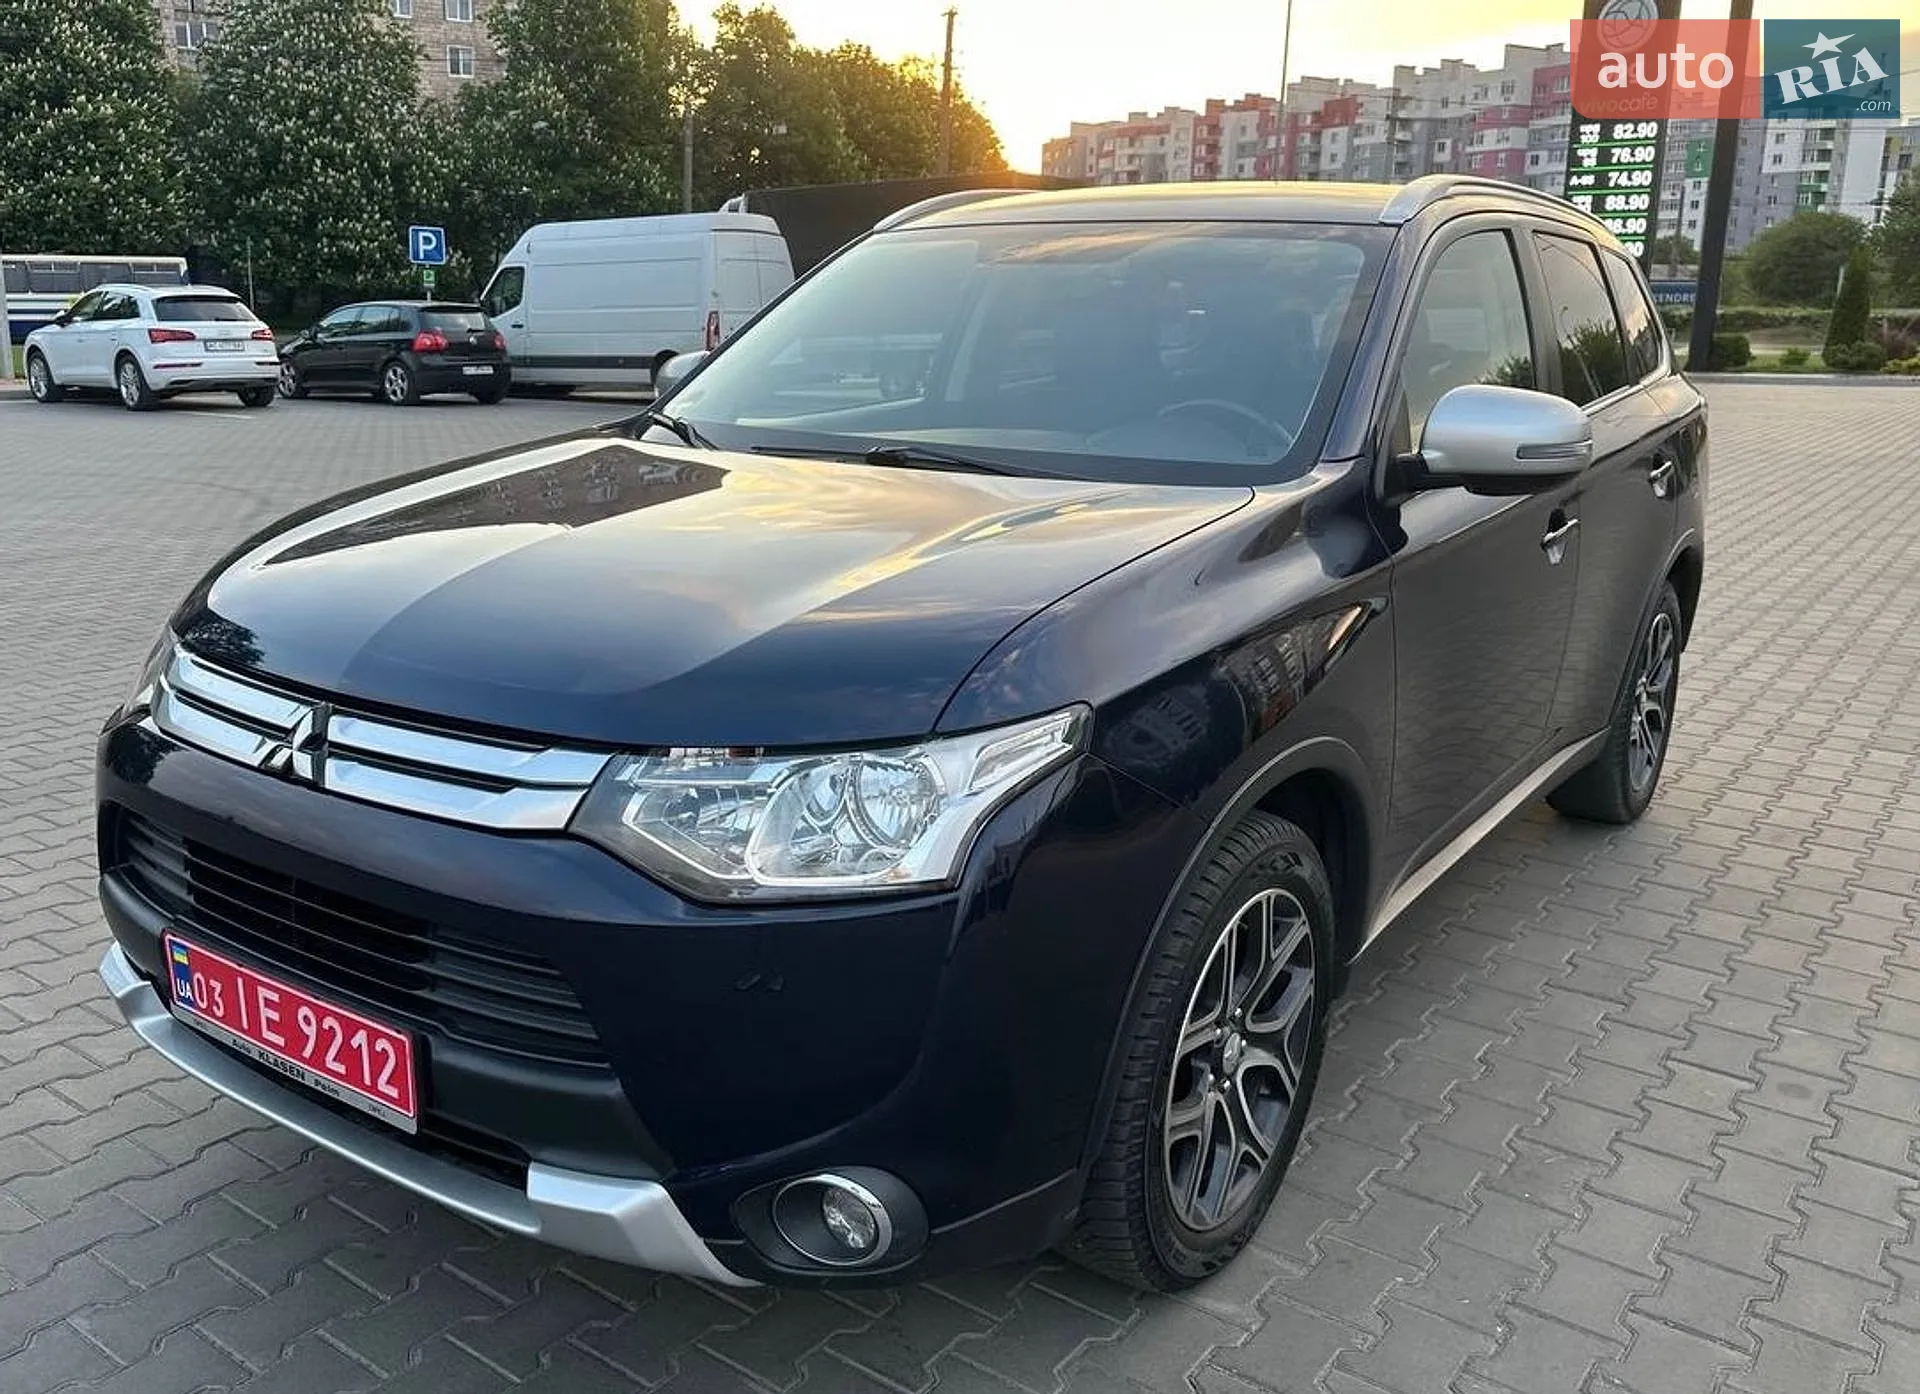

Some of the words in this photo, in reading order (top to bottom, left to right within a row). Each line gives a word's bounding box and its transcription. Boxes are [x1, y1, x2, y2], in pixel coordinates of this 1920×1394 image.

[1613, 121, 1658, 140] 82.90
[1608, 170, 1652, 187] 74.90
[418, 231, 437, 260] P
[176, 978, 193, 1000] UA
[193, 972, 224, 1018] 03
[237, 977, 285, 1048] IE
[297, 1005, 400, 1099] 9212
